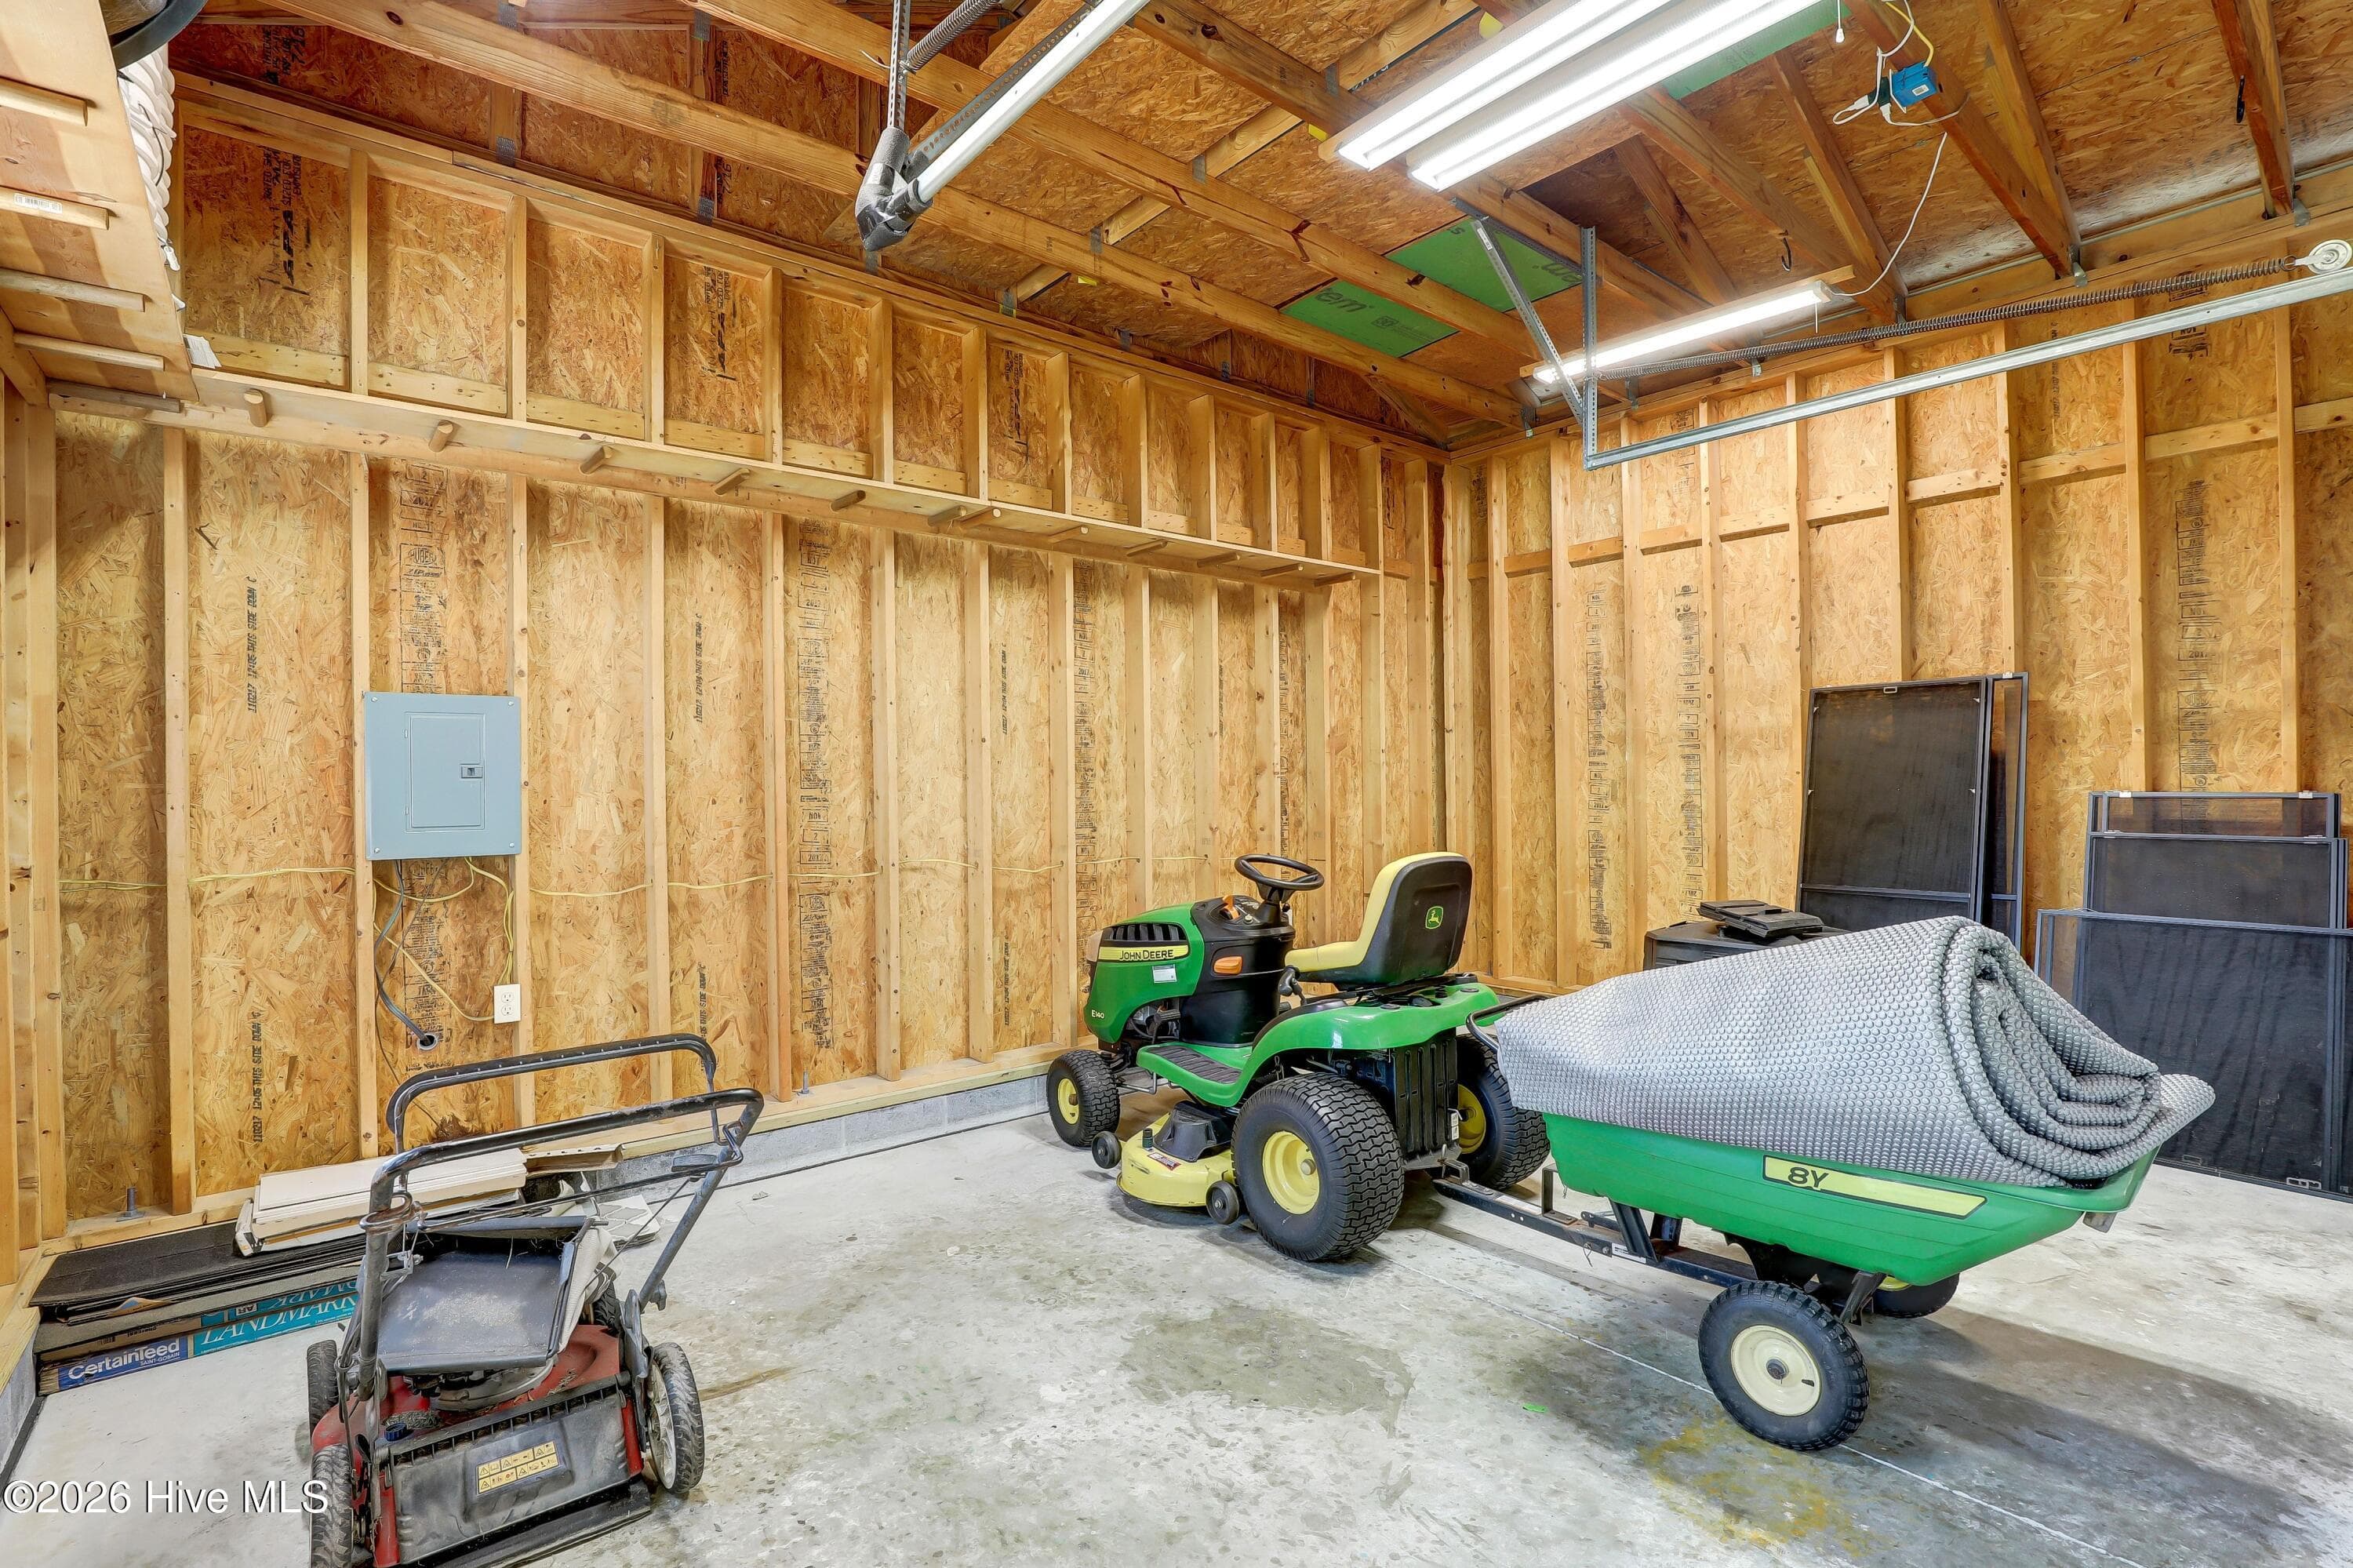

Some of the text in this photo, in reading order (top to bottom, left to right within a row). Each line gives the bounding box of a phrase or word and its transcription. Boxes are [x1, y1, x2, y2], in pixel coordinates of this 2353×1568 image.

[1119, 949, 1174, 960] JOHN DEERE
[1091, 1010, 1105, 1019] E140
[1787, 1166, 1830, 1188] 8Y
[237, 1304, 256, 1315] AR
[67, 1338, 180, 1380] CertainTeed
[140, 1351, 180, 1367] SAINT-GOBAIN
